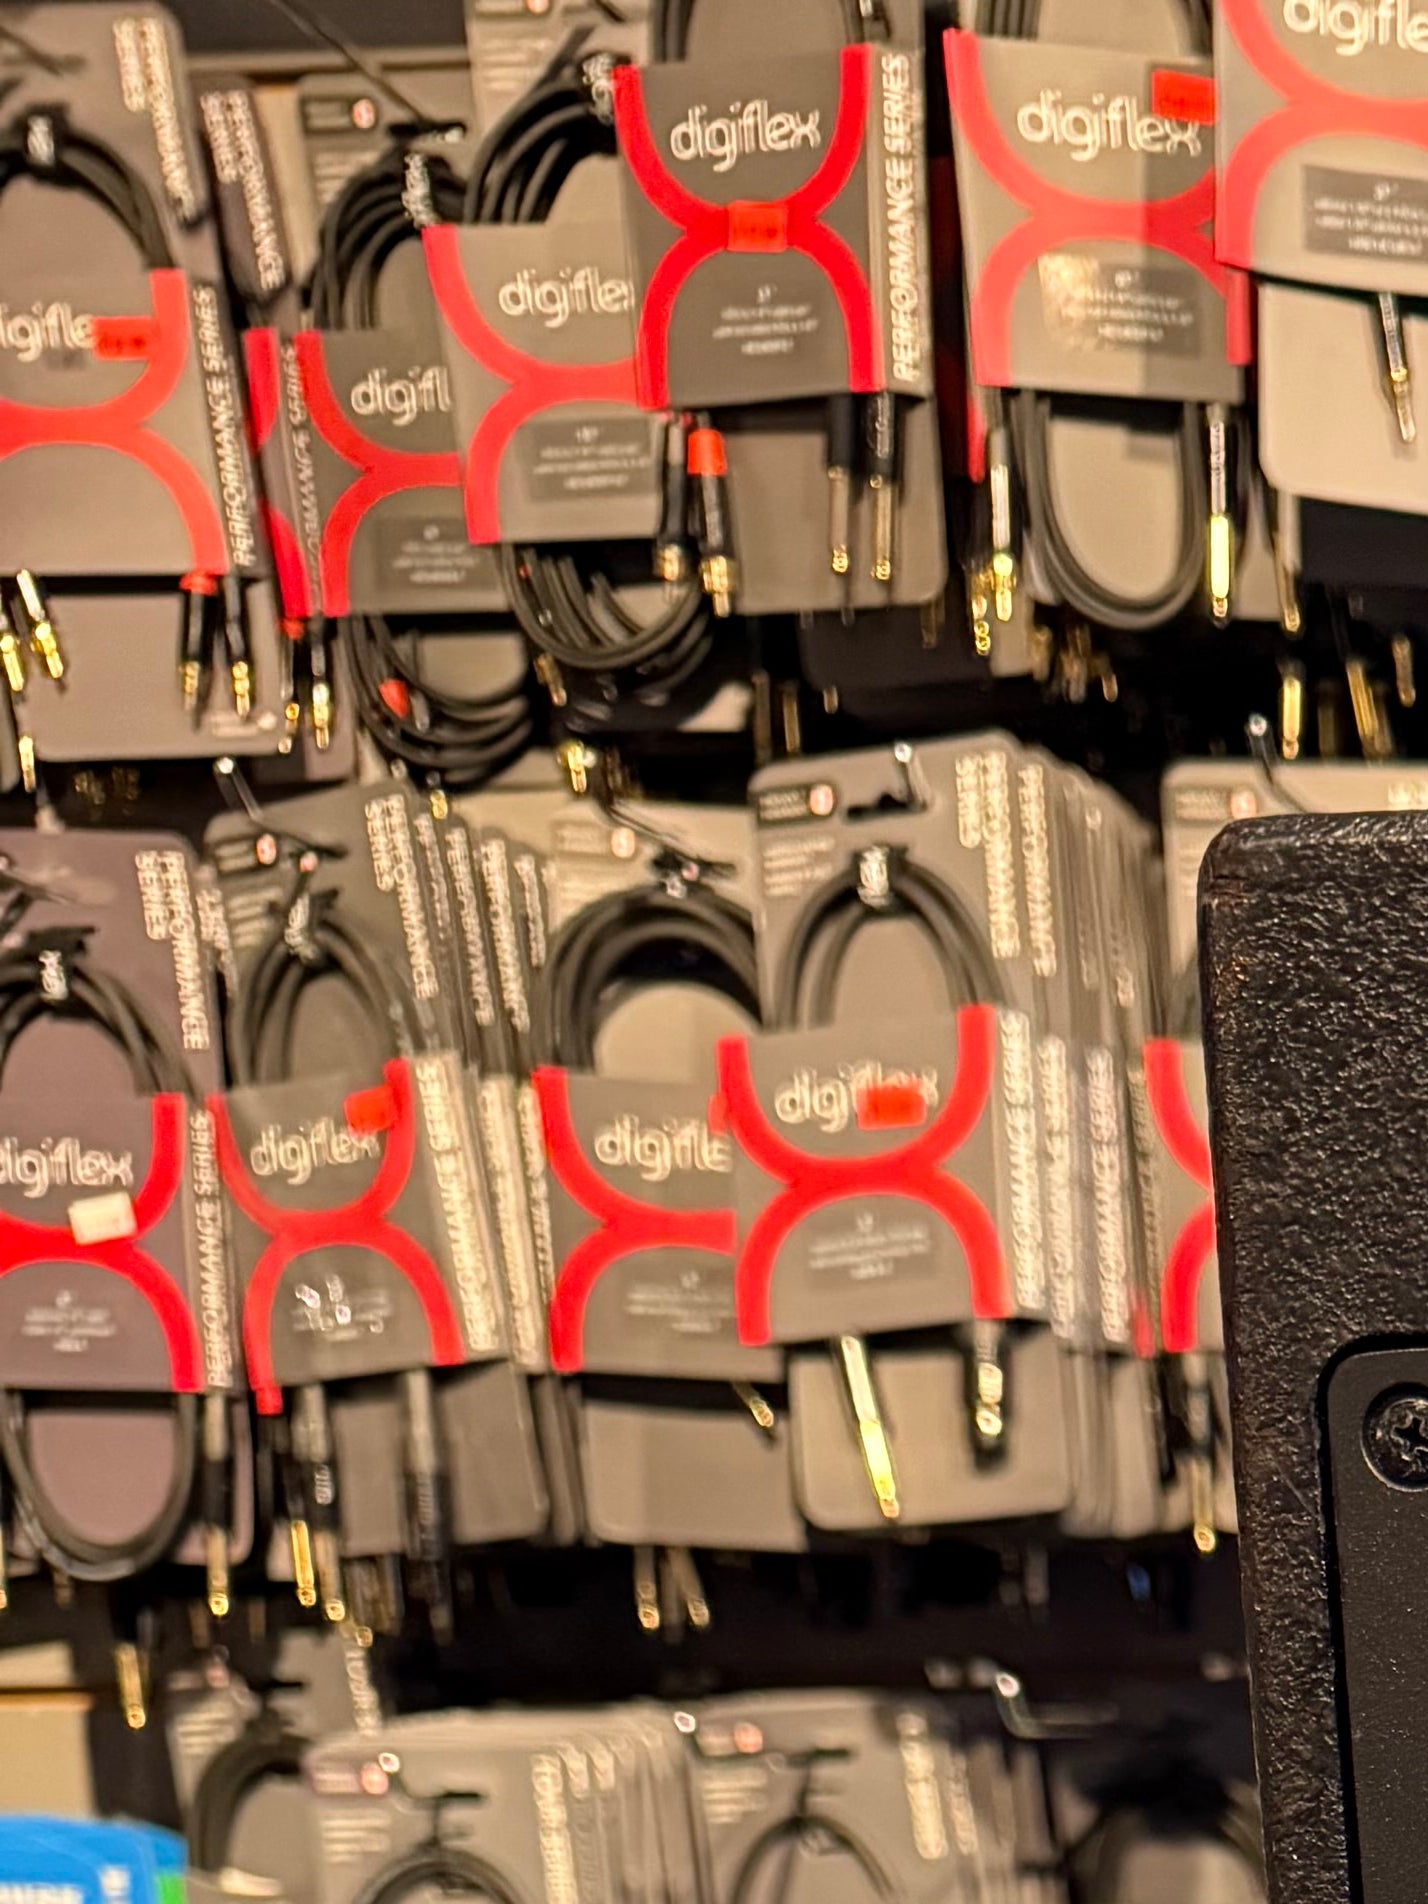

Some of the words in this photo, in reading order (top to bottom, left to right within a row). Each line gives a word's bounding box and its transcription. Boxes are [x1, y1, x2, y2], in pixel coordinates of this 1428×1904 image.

[670, 100, 821, 171] digiflex
[881, 53, 910, 153] SERIES
[1017, 92, 1201, 162] digiflex
[885, 157, 920, 382] PERFORMANCE
